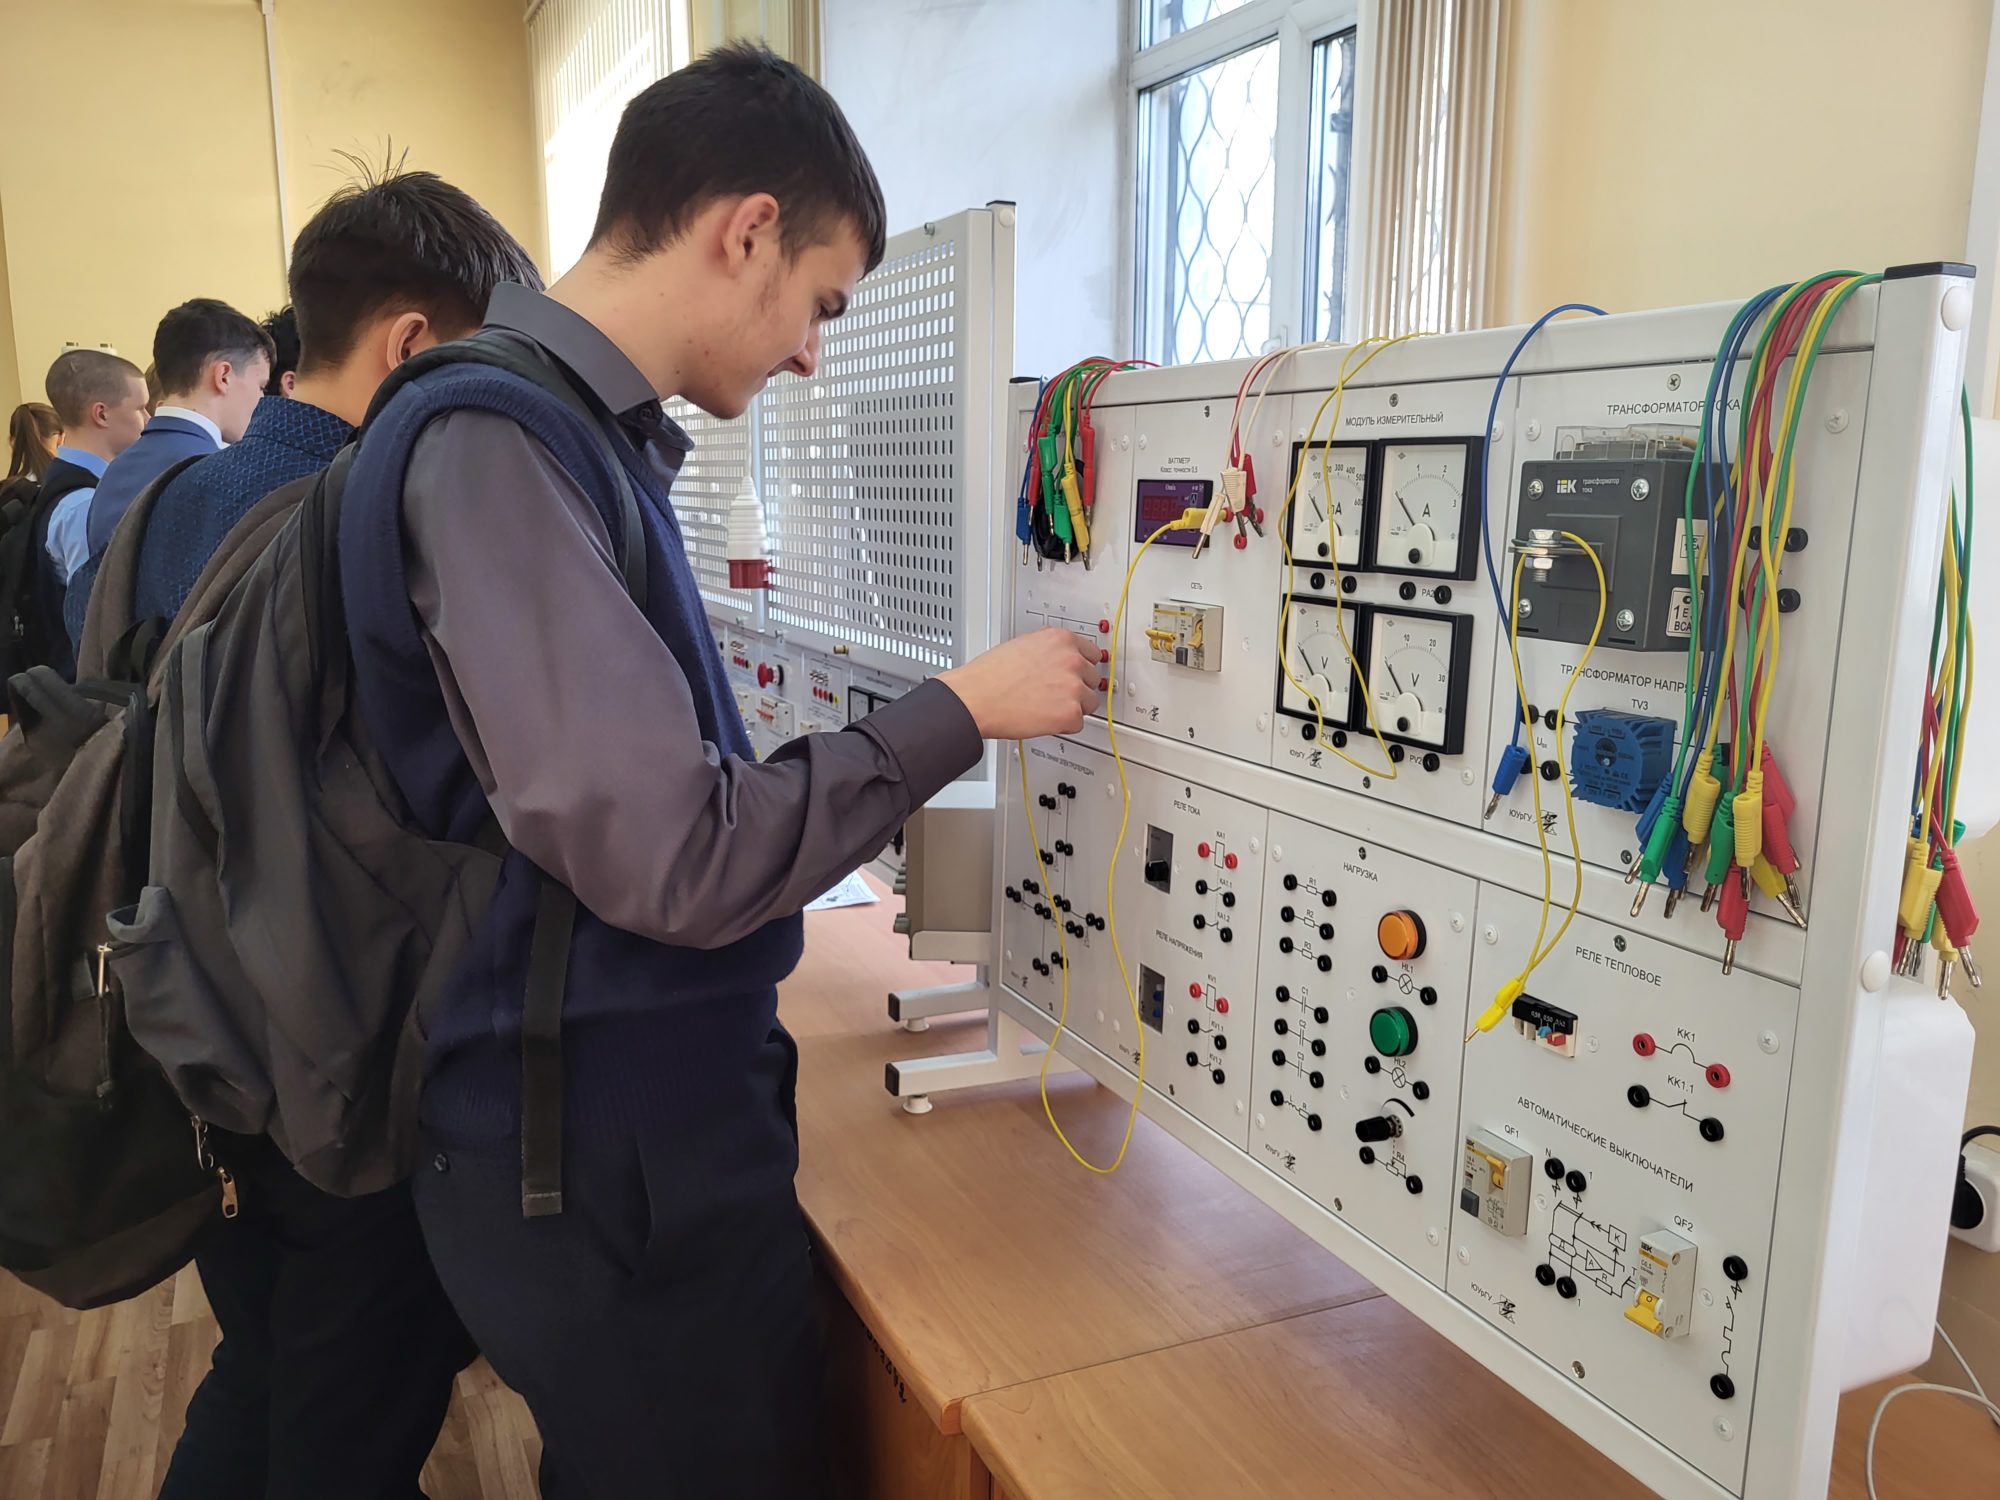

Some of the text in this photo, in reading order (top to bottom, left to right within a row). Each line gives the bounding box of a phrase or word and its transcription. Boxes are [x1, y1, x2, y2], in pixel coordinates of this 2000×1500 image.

[1606, 400, 1706, 416] ТРАНСФОРМАТОР
[1345, 411, 1444, 427] МОДУЛЬ ИЗМЕРИТЕЛЬНЫЙ
[1334, 463, 1344, 472] 300
[1346, 466, 1356, 475] 400
[1429, 638, 1437, 648] 20
[1321, 656, 1329, 669] V
[1411, 672, 1420, 687] V
[1438, 673, 1446, 683] 30
[1631, 698, 1649, 711] TV3
[1409, 754, 1423, 765] PV2
[1173, 800, 1201, 816] РЕЛЕ ТОКА
[1509, 809, 1532, 822] ЮУрГУ
[1343, 862, 1379, 883] НАГРУЗКА
[1308, 877, 1317, 886] R1
[1306, 909, 1314, 918] R2
[1155, 930, 1204, 960] РЕЛЕ НАПРЯЖЕНИЯ
[1304, 941, 1312, 950] R3
[1401, 962, 1414, 974] HL1
[1575, 946, 1663, 987] РЕЛЕ ТЕПЛОВОЕ
[1394, 1057, 1407, 1069] HL2
[1504, 1124, 1520, 1138] QF1
[1517, 1096, 1694, 1193] АВТОМАТИЧЕСКИЕ ВЫКЛЮЧАТЕЛИ
[1396, 1151, 1405, 1162] R4
[1545, 1148, 1552, 1158] N
[1673, 1215, 1694, 1233] QF2
[1601, 1273, 1608, 1282] R
[1470, 1281, 1493, 1301] ЮУрГУ
